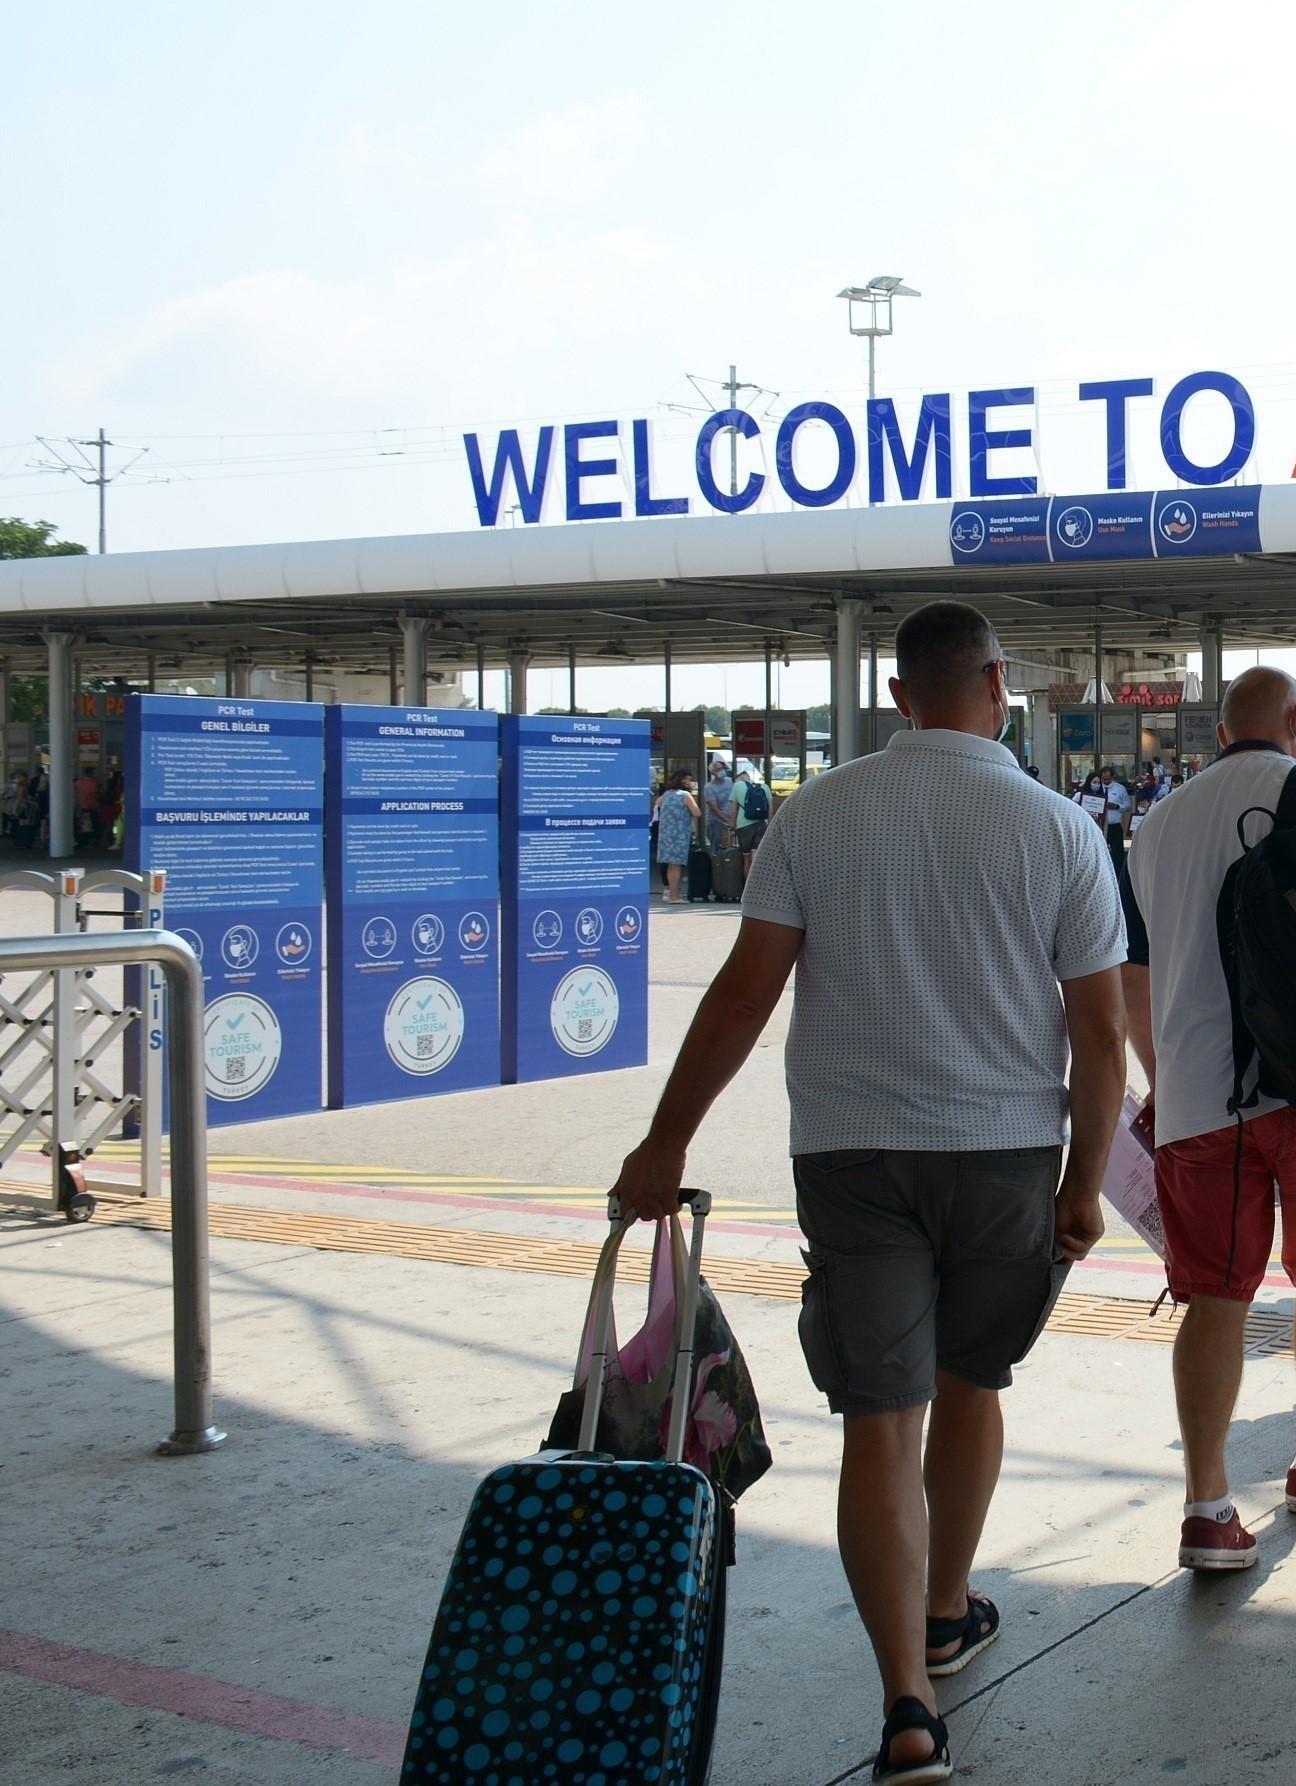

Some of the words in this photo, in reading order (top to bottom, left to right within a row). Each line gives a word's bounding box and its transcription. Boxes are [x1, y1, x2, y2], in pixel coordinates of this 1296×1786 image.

[464, 387, 1037, 527] WELCOME
[1079, 371, 1256, 490] TO
[1202, 511, 1230, 519] Ellerinizi
[1231, 510, 1254, 518] Yıkayın
[990, 517, 1007, 525] Sosyal
[1098, 517, 1117, 525] Maske
[989, 526, 1014, 534] Koruyun
[218, 705, 236, 716] PCR
[236, 706, 254, 716] Test
[406, 713, 422, 723] PCR
[423, 714, 438, 723] Test
[201, 721, 231, 732] GENEL
[232, 721, 270, 733] BİLGİLER
[378, 726, 414, 736] GENERAL
[415, 727, 465, 737] INFORMATION
[573, 722, 587, 731] PCR
[587, 723, 600, 732] Test
[551, 734, 581, 743] Основная
[582, 735, 622, 745] информация
[381, 802, 430, 811] APPLICATION
[431, 801, 464, 811] PROCESS
[156, 812, 199, 824] BAŞVURU
[200, 810, 247, 824] İŞLEMİNDE
[249, 812, 309, 822] YAPILACAKLAR
[545, 818, 551, 826] В
[150, 908, 162, 1050] PLİS
[575, 999, 597, 1010] SAFE
[411, 1012, 438, 1024] SAFE
[565, 1008, 605, 1020] TOURISM
[402, 1022, 448, 1036] TOURISM
[221, 1032, 249, 1045] SAFE
[209, 1043, 262, 1057] TOURISM
